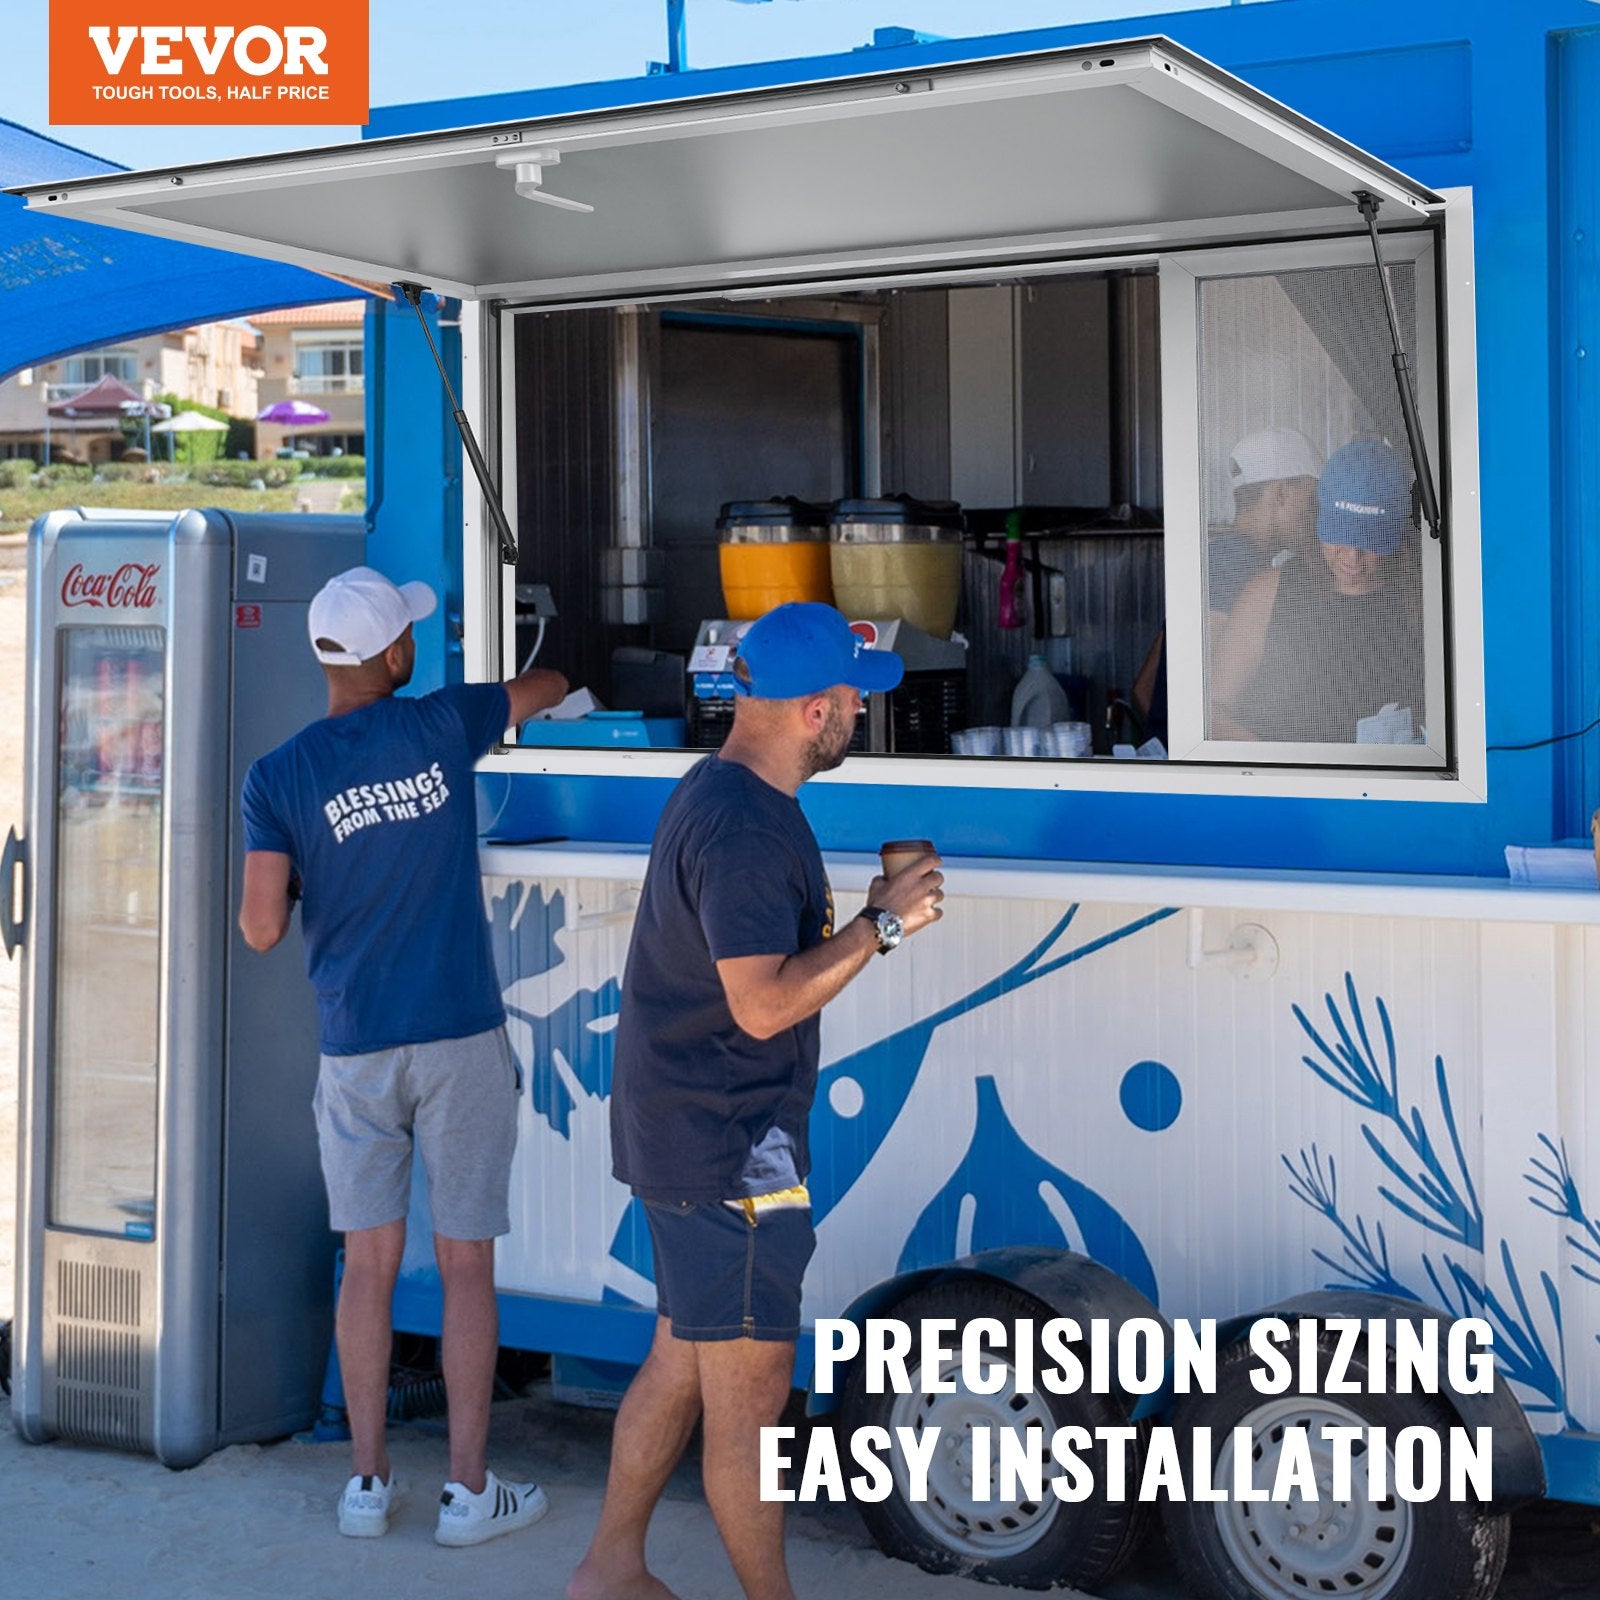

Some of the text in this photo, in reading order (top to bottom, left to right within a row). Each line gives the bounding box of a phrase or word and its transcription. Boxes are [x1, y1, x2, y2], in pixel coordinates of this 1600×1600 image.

[324, 762, 443, 826] BLESSINGS
[333, 784, 450, 844] FROM THE SEA
